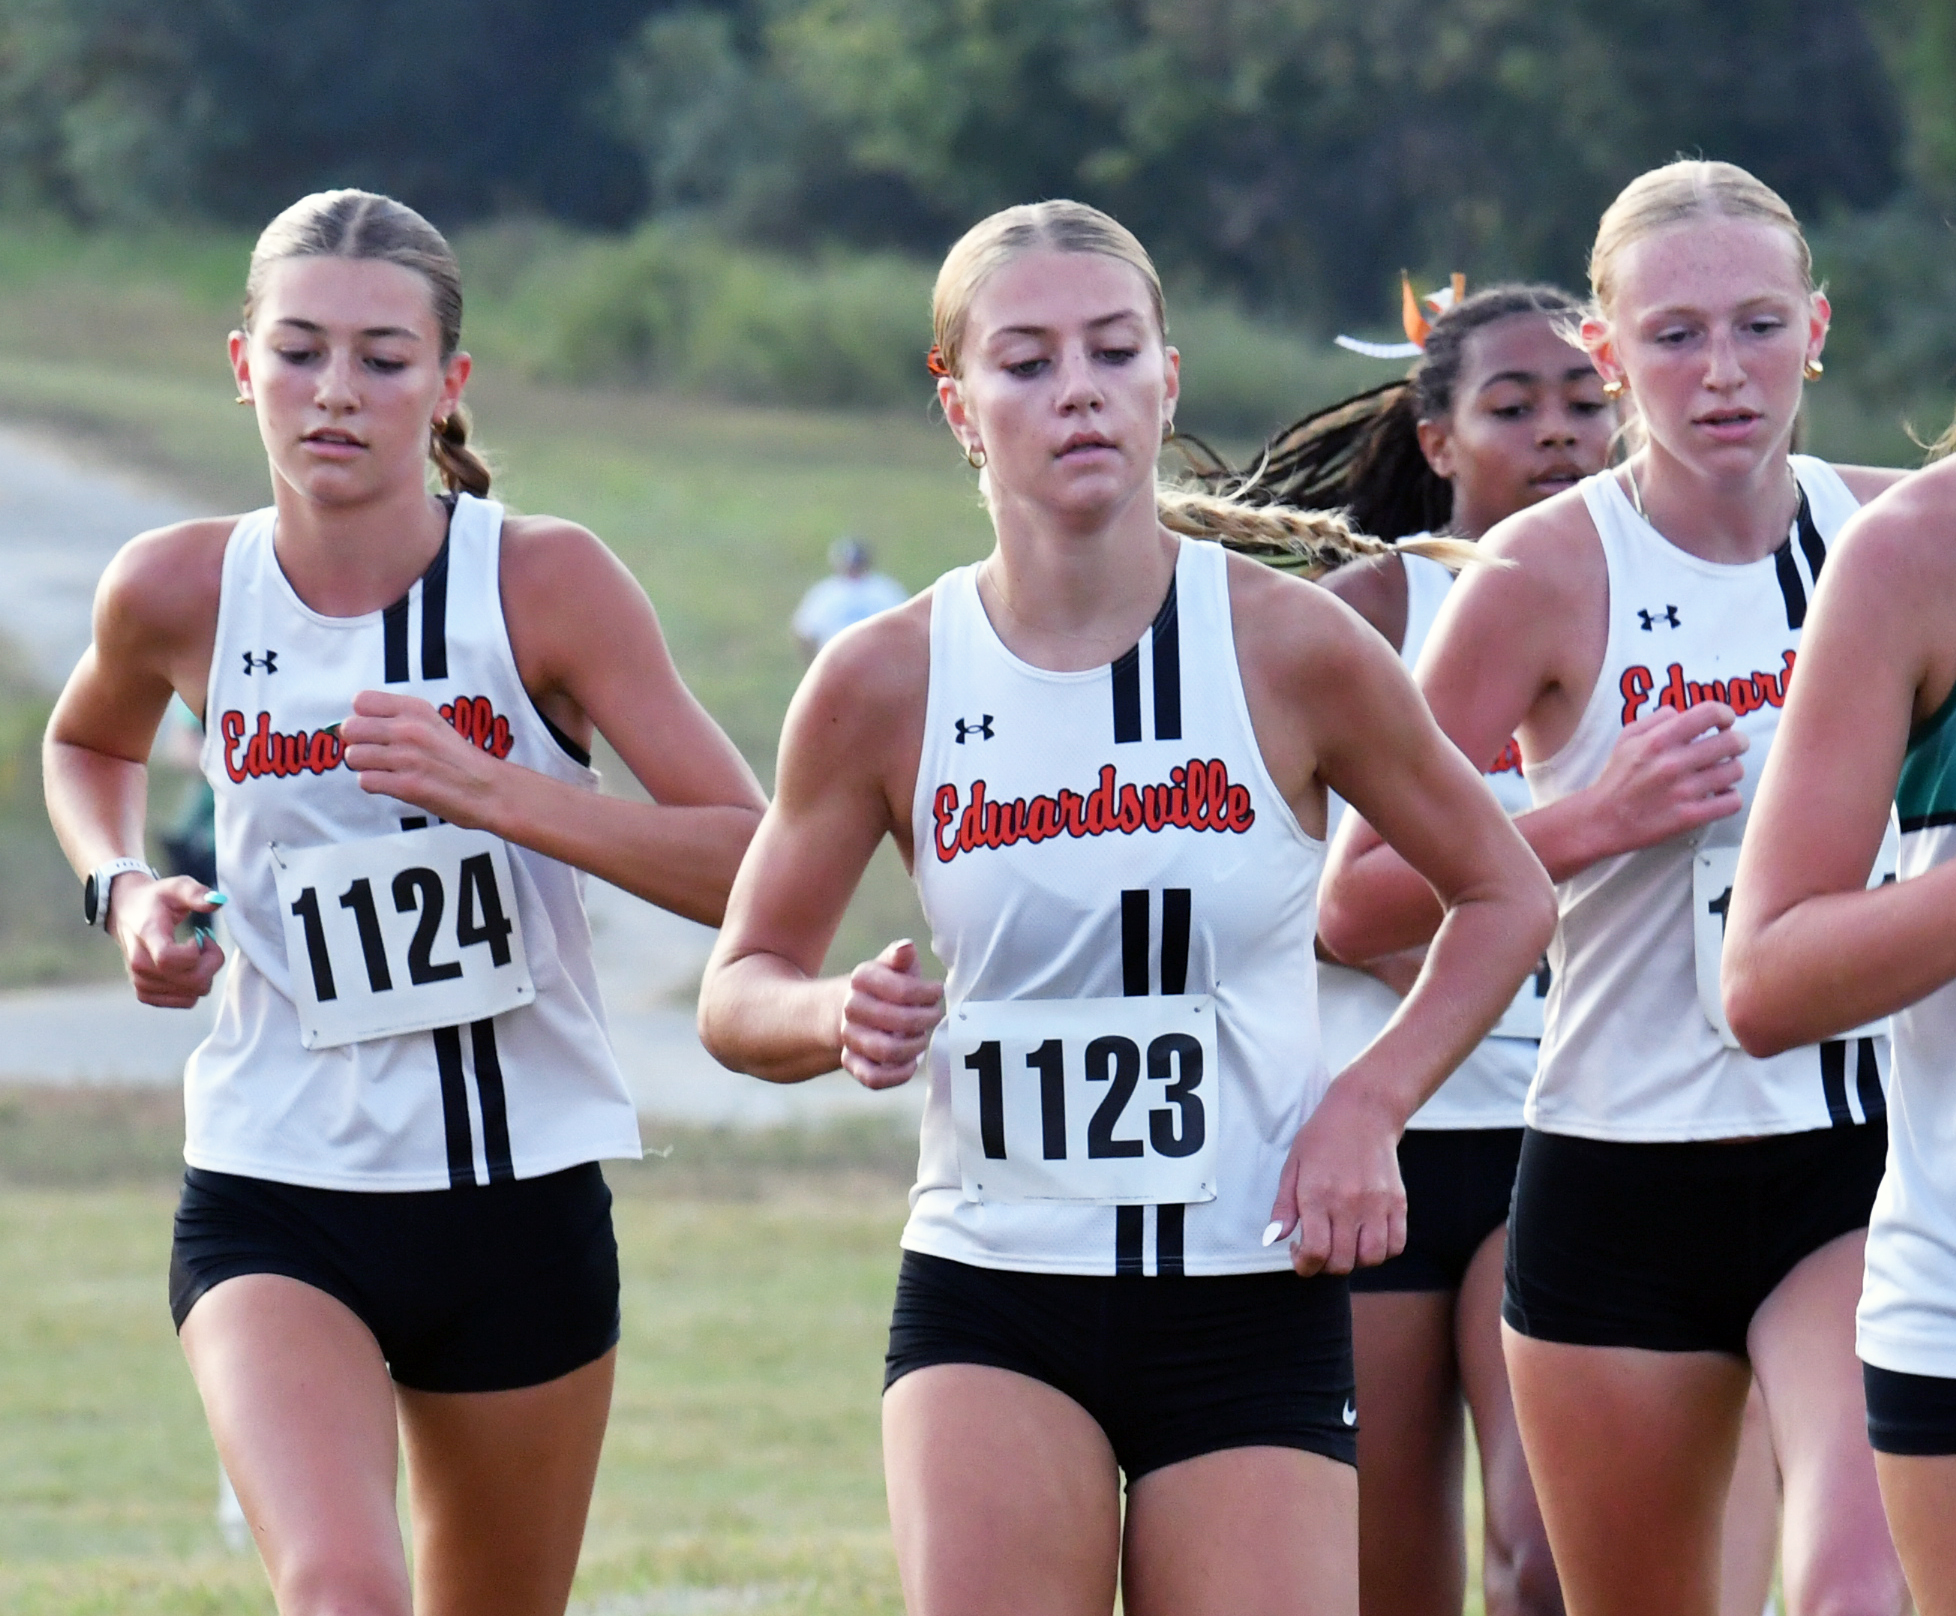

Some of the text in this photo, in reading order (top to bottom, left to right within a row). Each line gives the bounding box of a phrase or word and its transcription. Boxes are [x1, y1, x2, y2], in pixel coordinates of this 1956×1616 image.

[933, 757, 1255, 863] Edwardsville
[291, 852, 513, 1002] 1124
[964, 1032, 1206, 1160] 1123
